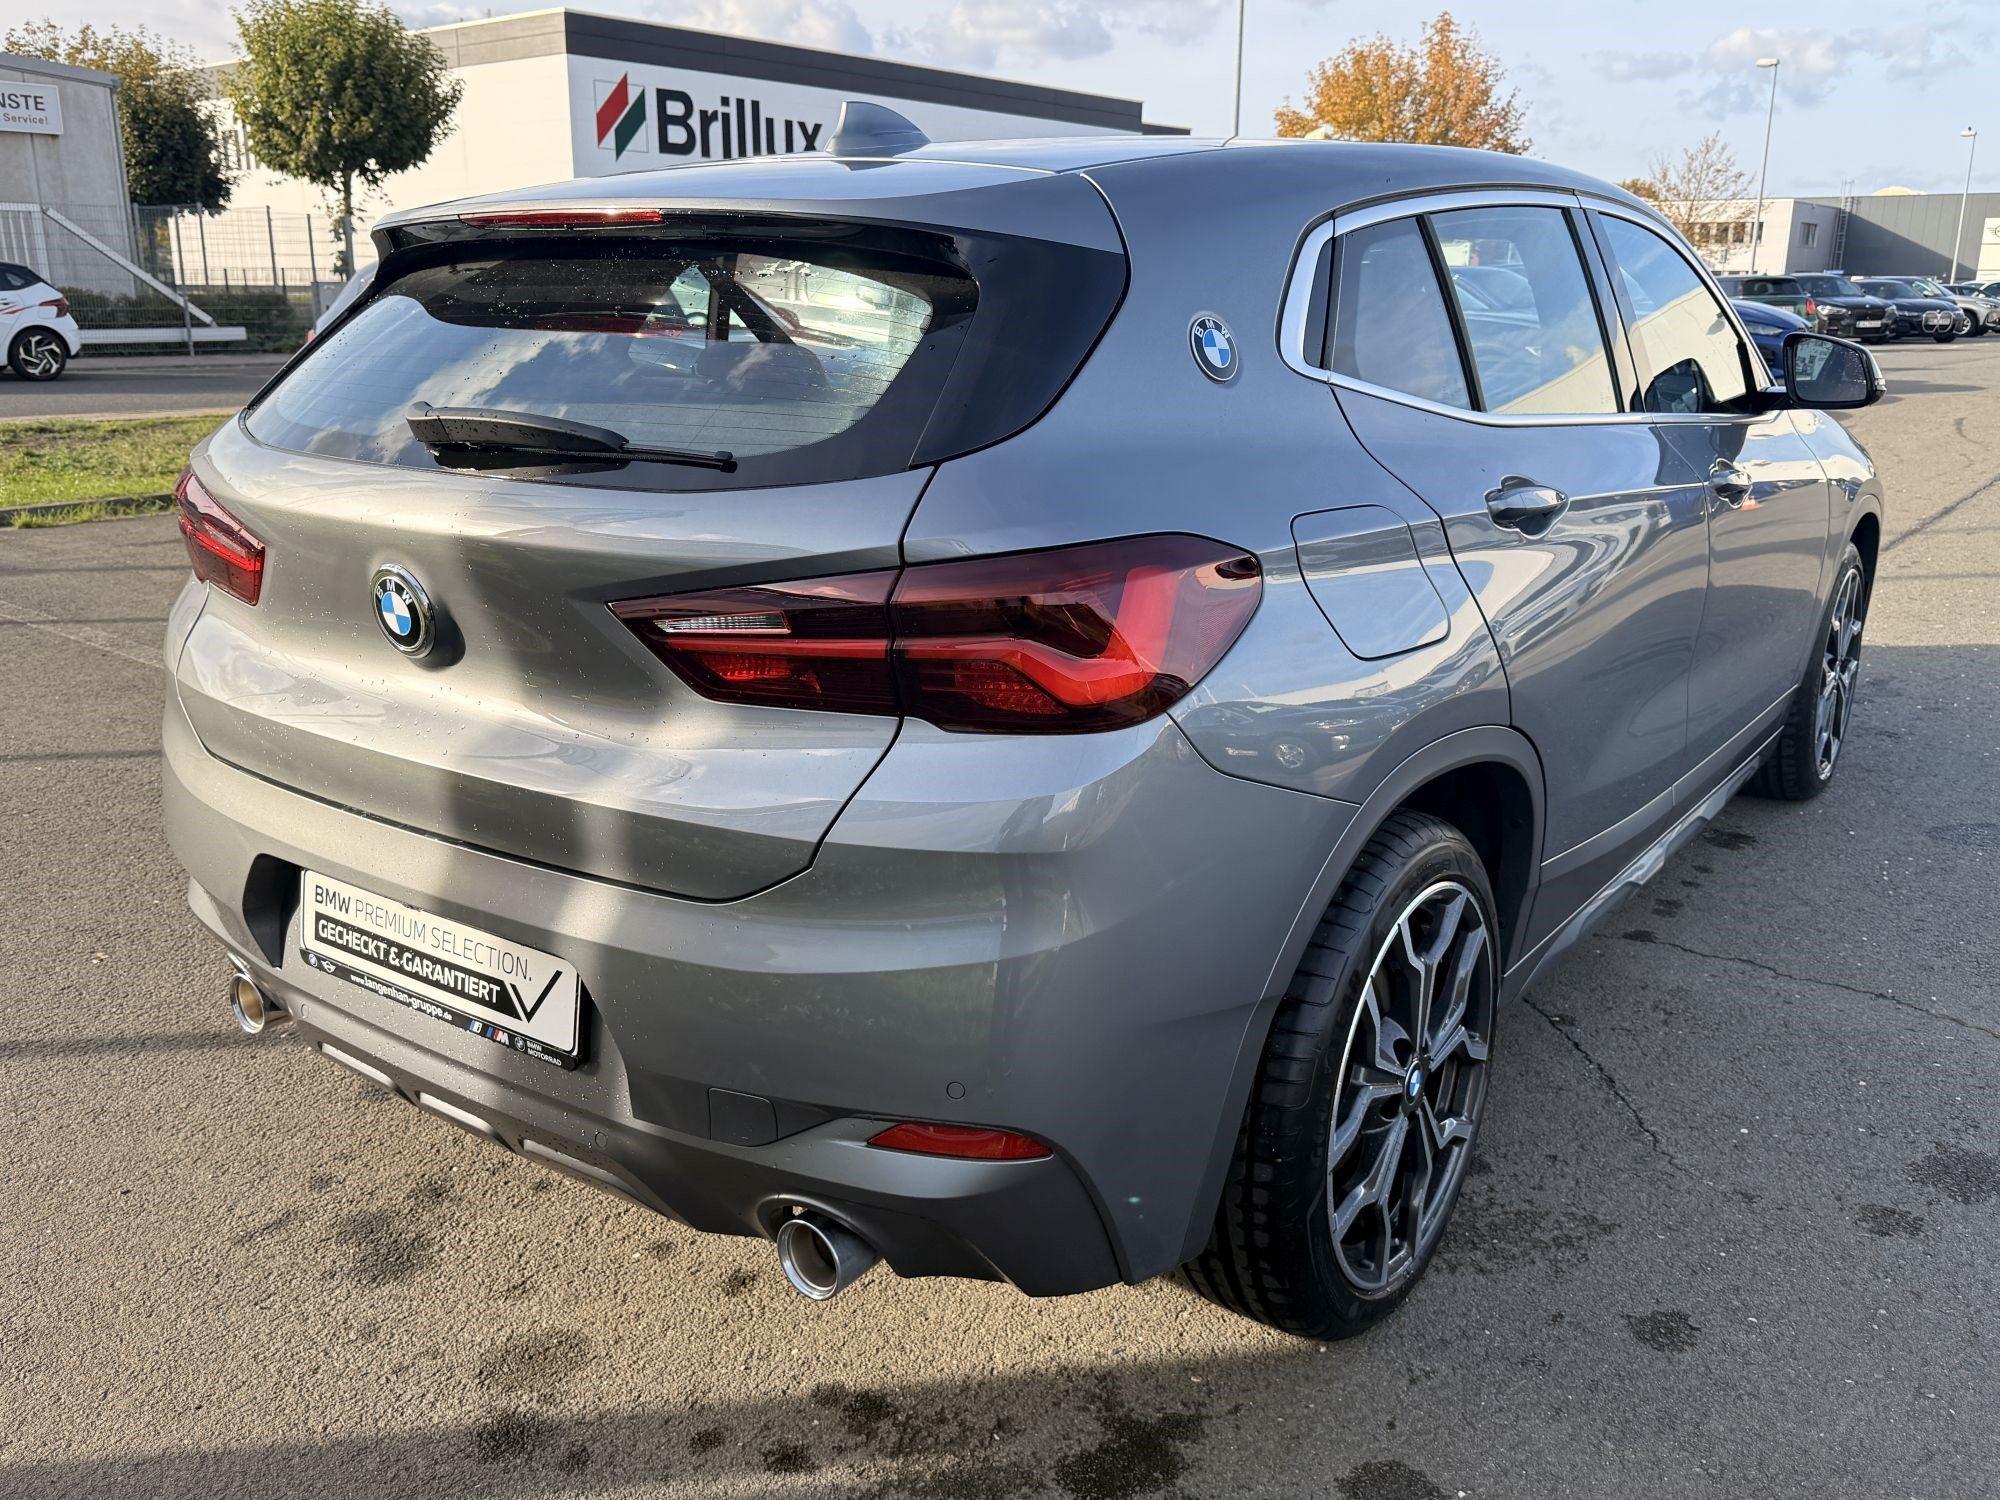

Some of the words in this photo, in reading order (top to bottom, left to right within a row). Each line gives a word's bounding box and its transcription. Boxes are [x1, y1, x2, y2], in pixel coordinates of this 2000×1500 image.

[656, 88, 823, 159] Brillux
[1194, 319, 1230, 338] BMW
[376, 579, 413, 605] BMW
[314, 884, 351, 915] BMW
[355, 899, 426, 944] PREMIUM
[431, 927, 533, 982] SELECTION.
[318, 919, 386, 962] GECHECKT
[389, 945, 402, 965] &
[402, 949, 501, 1004] GARANTIERT
[350, 974, 453, 1021] www.langenhan-gruppe.de
[526, 1040, 542, 1052] BMW
